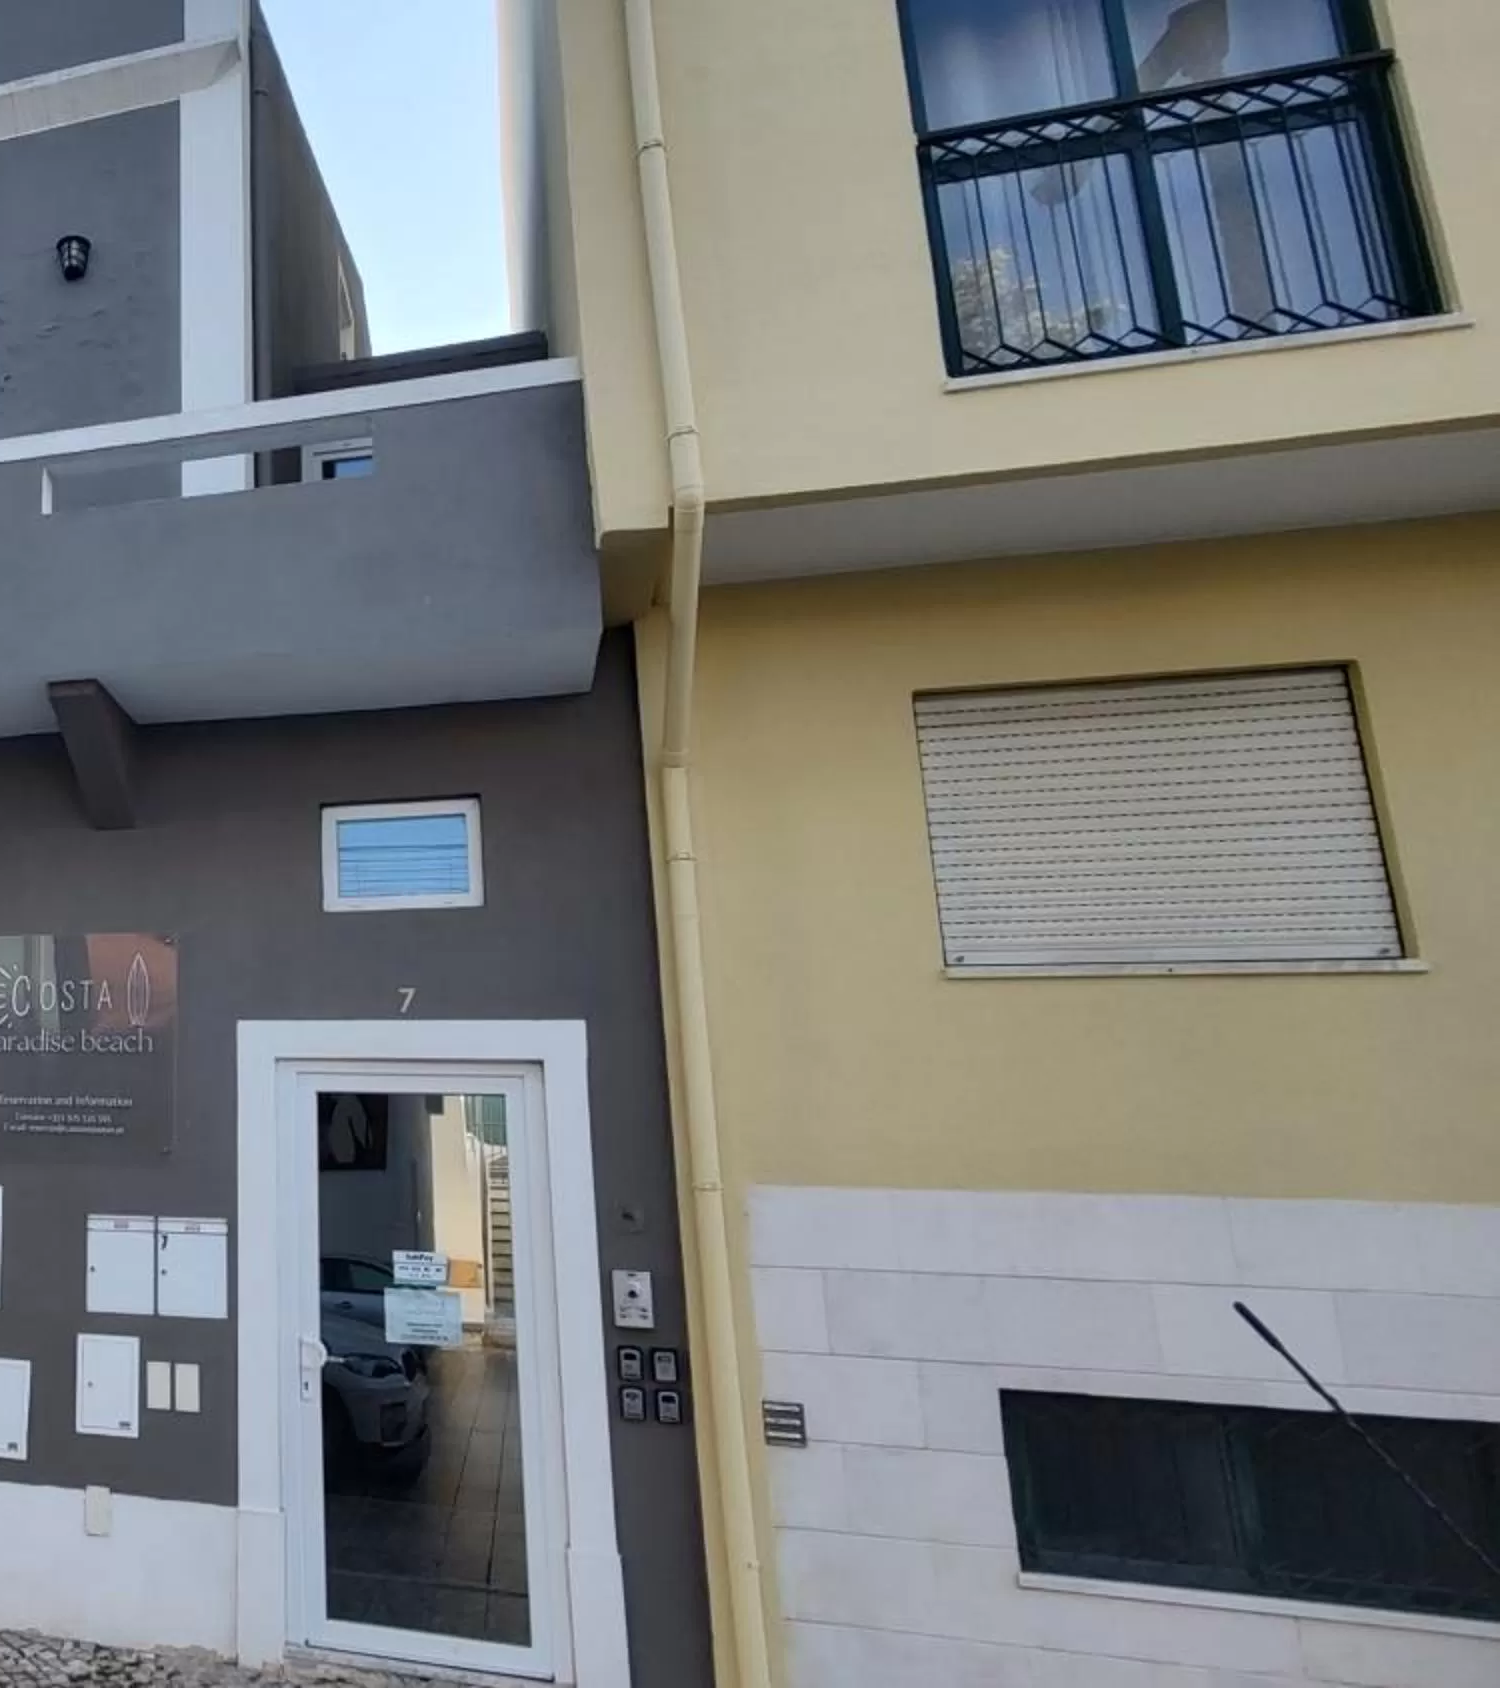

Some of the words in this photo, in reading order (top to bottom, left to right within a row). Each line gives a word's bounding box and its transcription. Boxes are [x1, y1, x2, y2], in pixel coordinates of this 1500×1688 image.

[11, 975, 113, 1017] COSTA
[397, 987, 416, 1013] 7
[81, 1028, 154, 1053] beach
